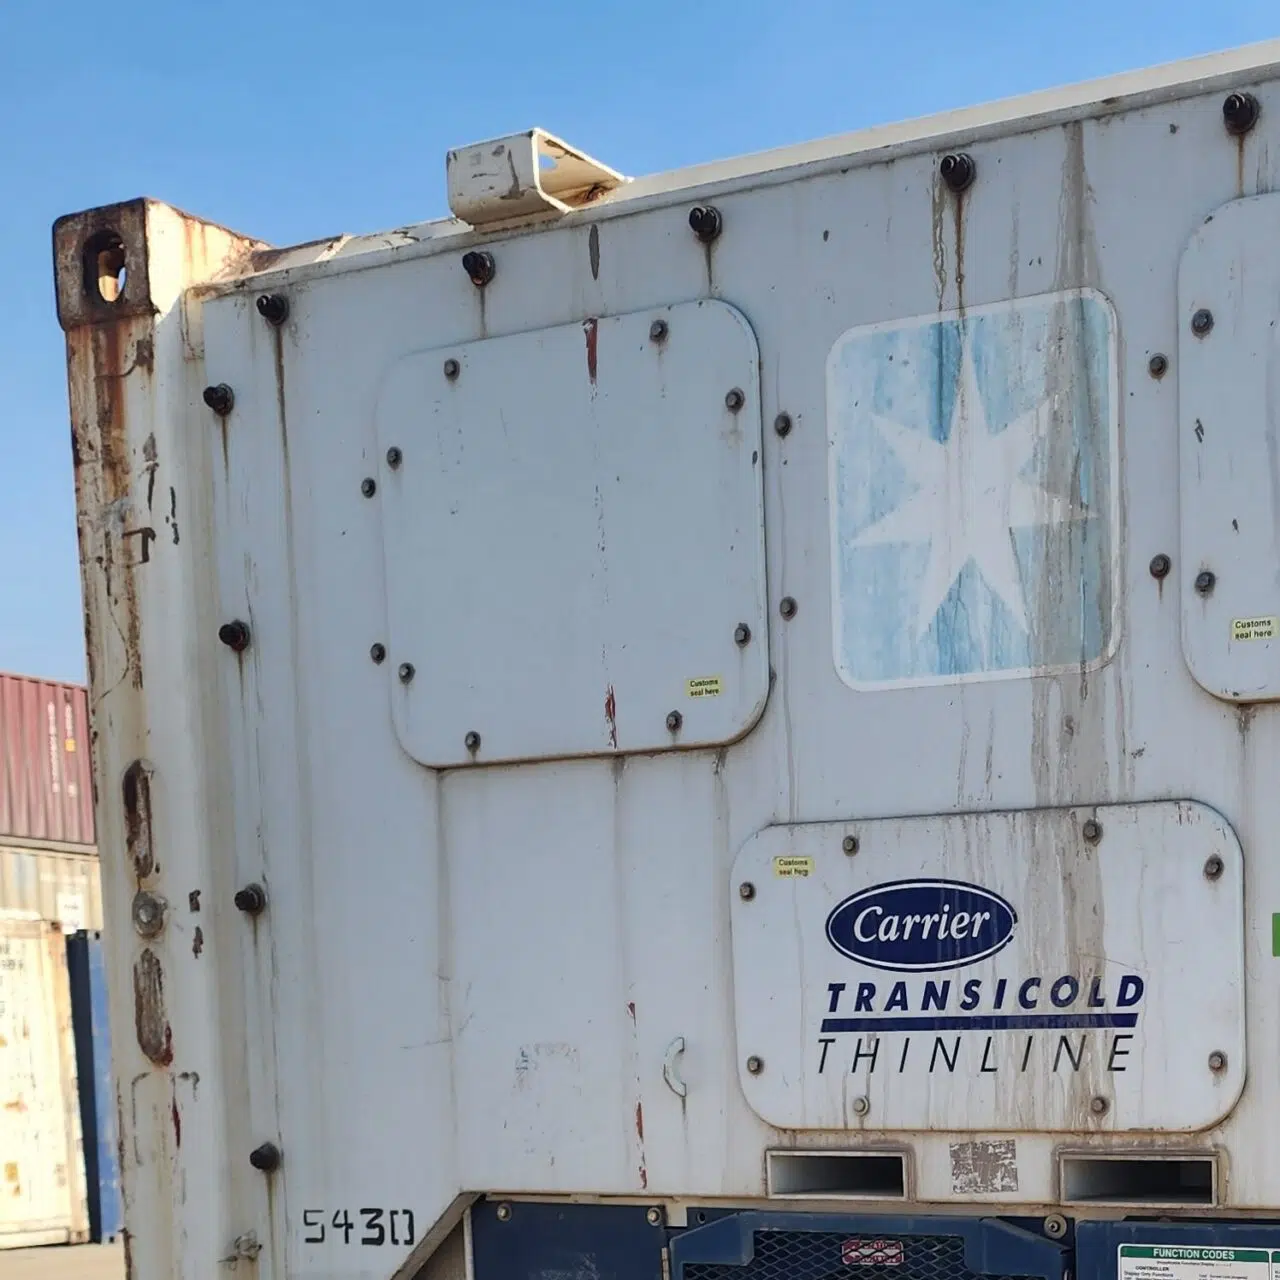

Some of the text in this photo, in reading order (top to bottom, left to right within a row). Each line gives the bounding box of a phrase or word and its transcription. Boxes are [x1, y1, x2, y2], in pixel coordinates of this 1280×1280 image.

[1235, 619, 1271, 629] Customs
[1235, 629, 1272, 640] seal here
[689, 679, 718, 687] Customs
[690, 688, 703, 696] seal
[779, 858, 808, 866] Customs
[853, 905, 990, 942] Carrier
[827, 975, 1145, 1013] TRANSICOLD
[818, 1034, 1134, 1075] THINLINE
[1153, 1248, 1235, 1260] FUNCTION CODES
